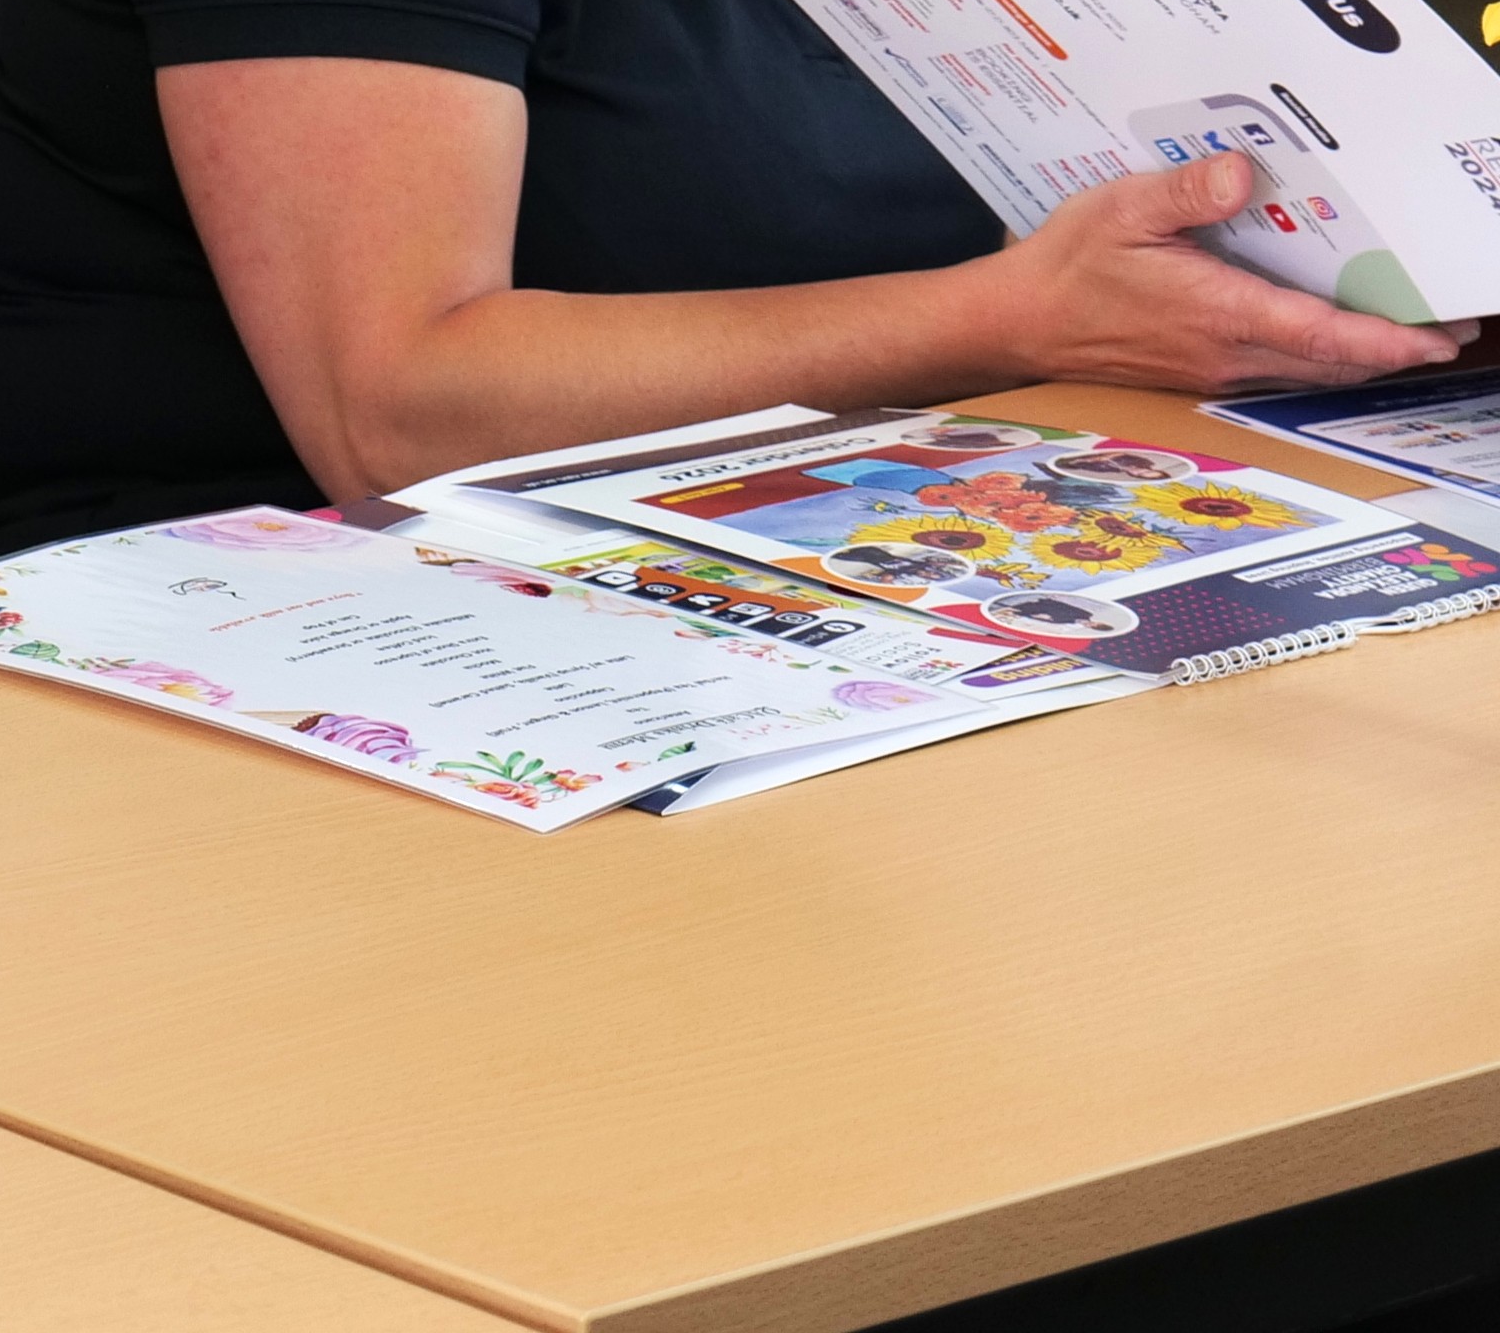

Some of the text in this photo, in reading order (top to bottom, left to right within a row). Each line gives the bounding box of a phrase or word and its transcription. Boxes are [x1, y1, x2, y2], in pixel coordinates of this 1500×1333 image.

[1314, 570, 1420, 600] ALEXANDRA
[1320, 564, 1401, 589] CHARITY
[1384, 578, 1439, 597] QUEEN
